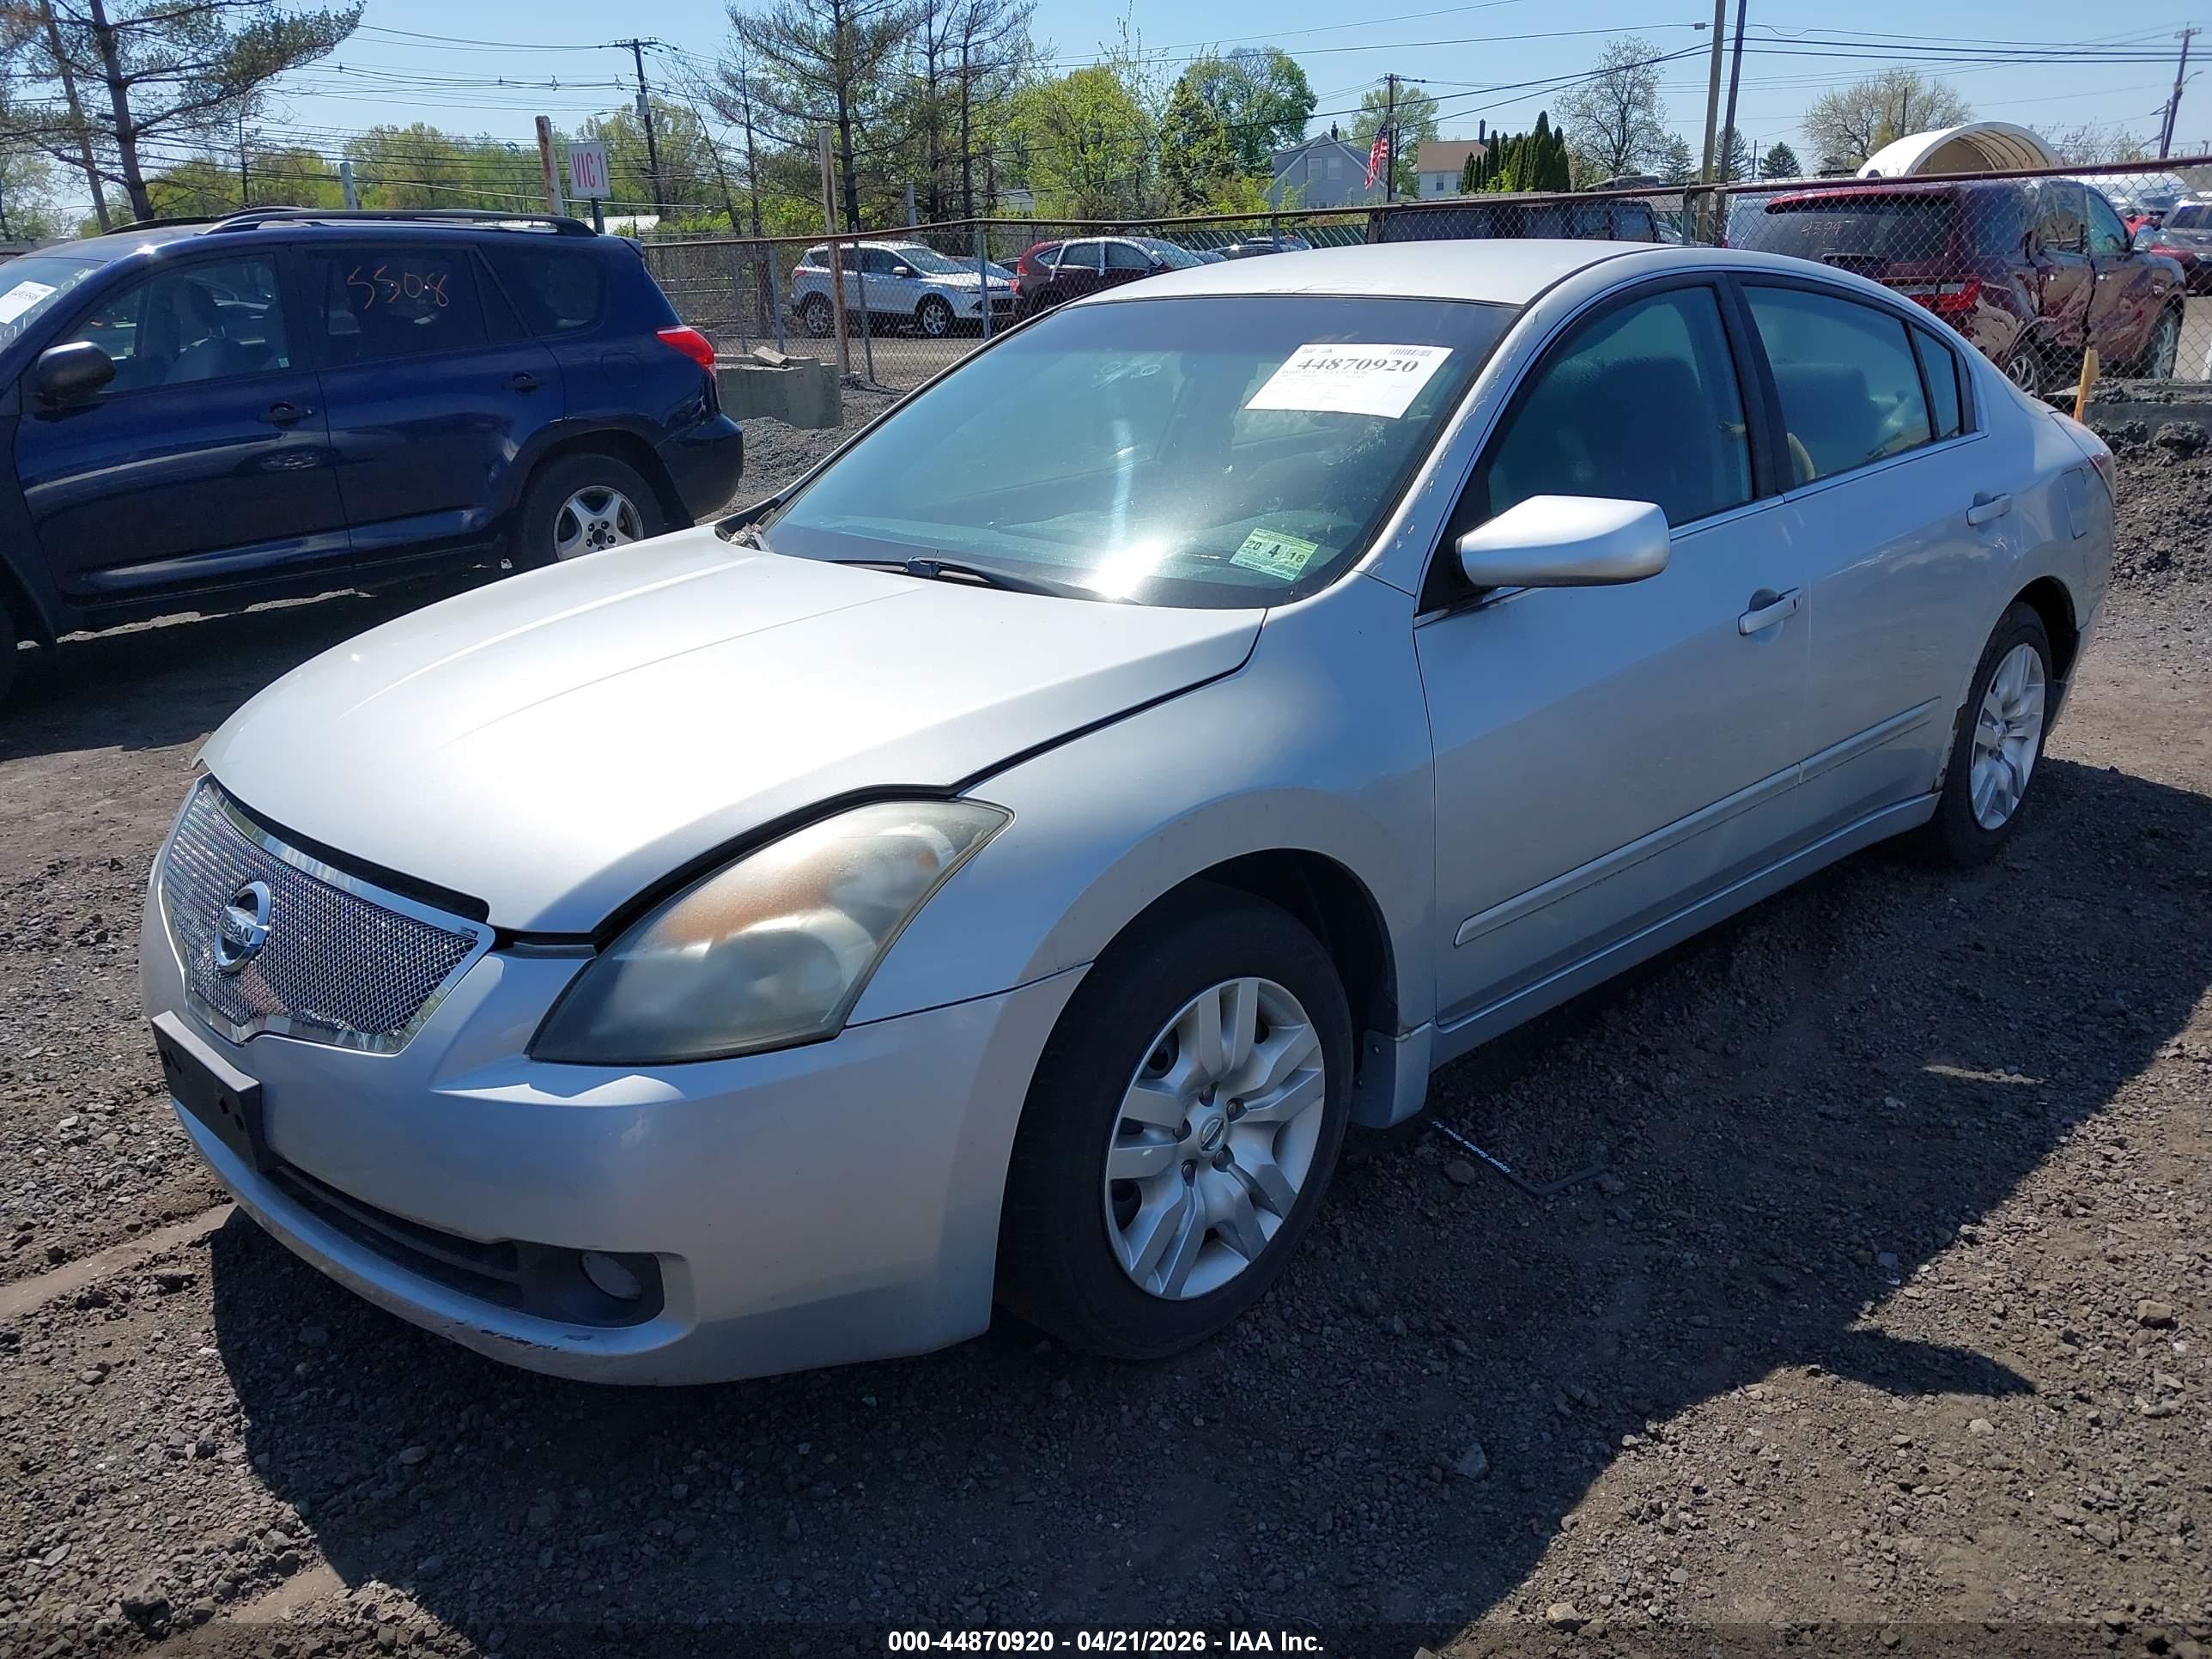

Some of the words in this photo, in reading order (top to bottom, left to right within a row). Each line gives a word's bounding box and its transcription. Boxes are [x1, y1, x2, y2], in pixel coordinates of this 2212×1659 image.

[572, 152, 596, 188] VIC
[598, 152, 605, 187] 1
[347, 265, 449, 309] 5508
[1297, 357, 1419, 373] 44870920
[1244, 540, 1262, 550] 20
[1268, 544, 1281, 557] 4
[1290, 551, 1305, 563] 18
[218, 919, 254, 943] SSAN
